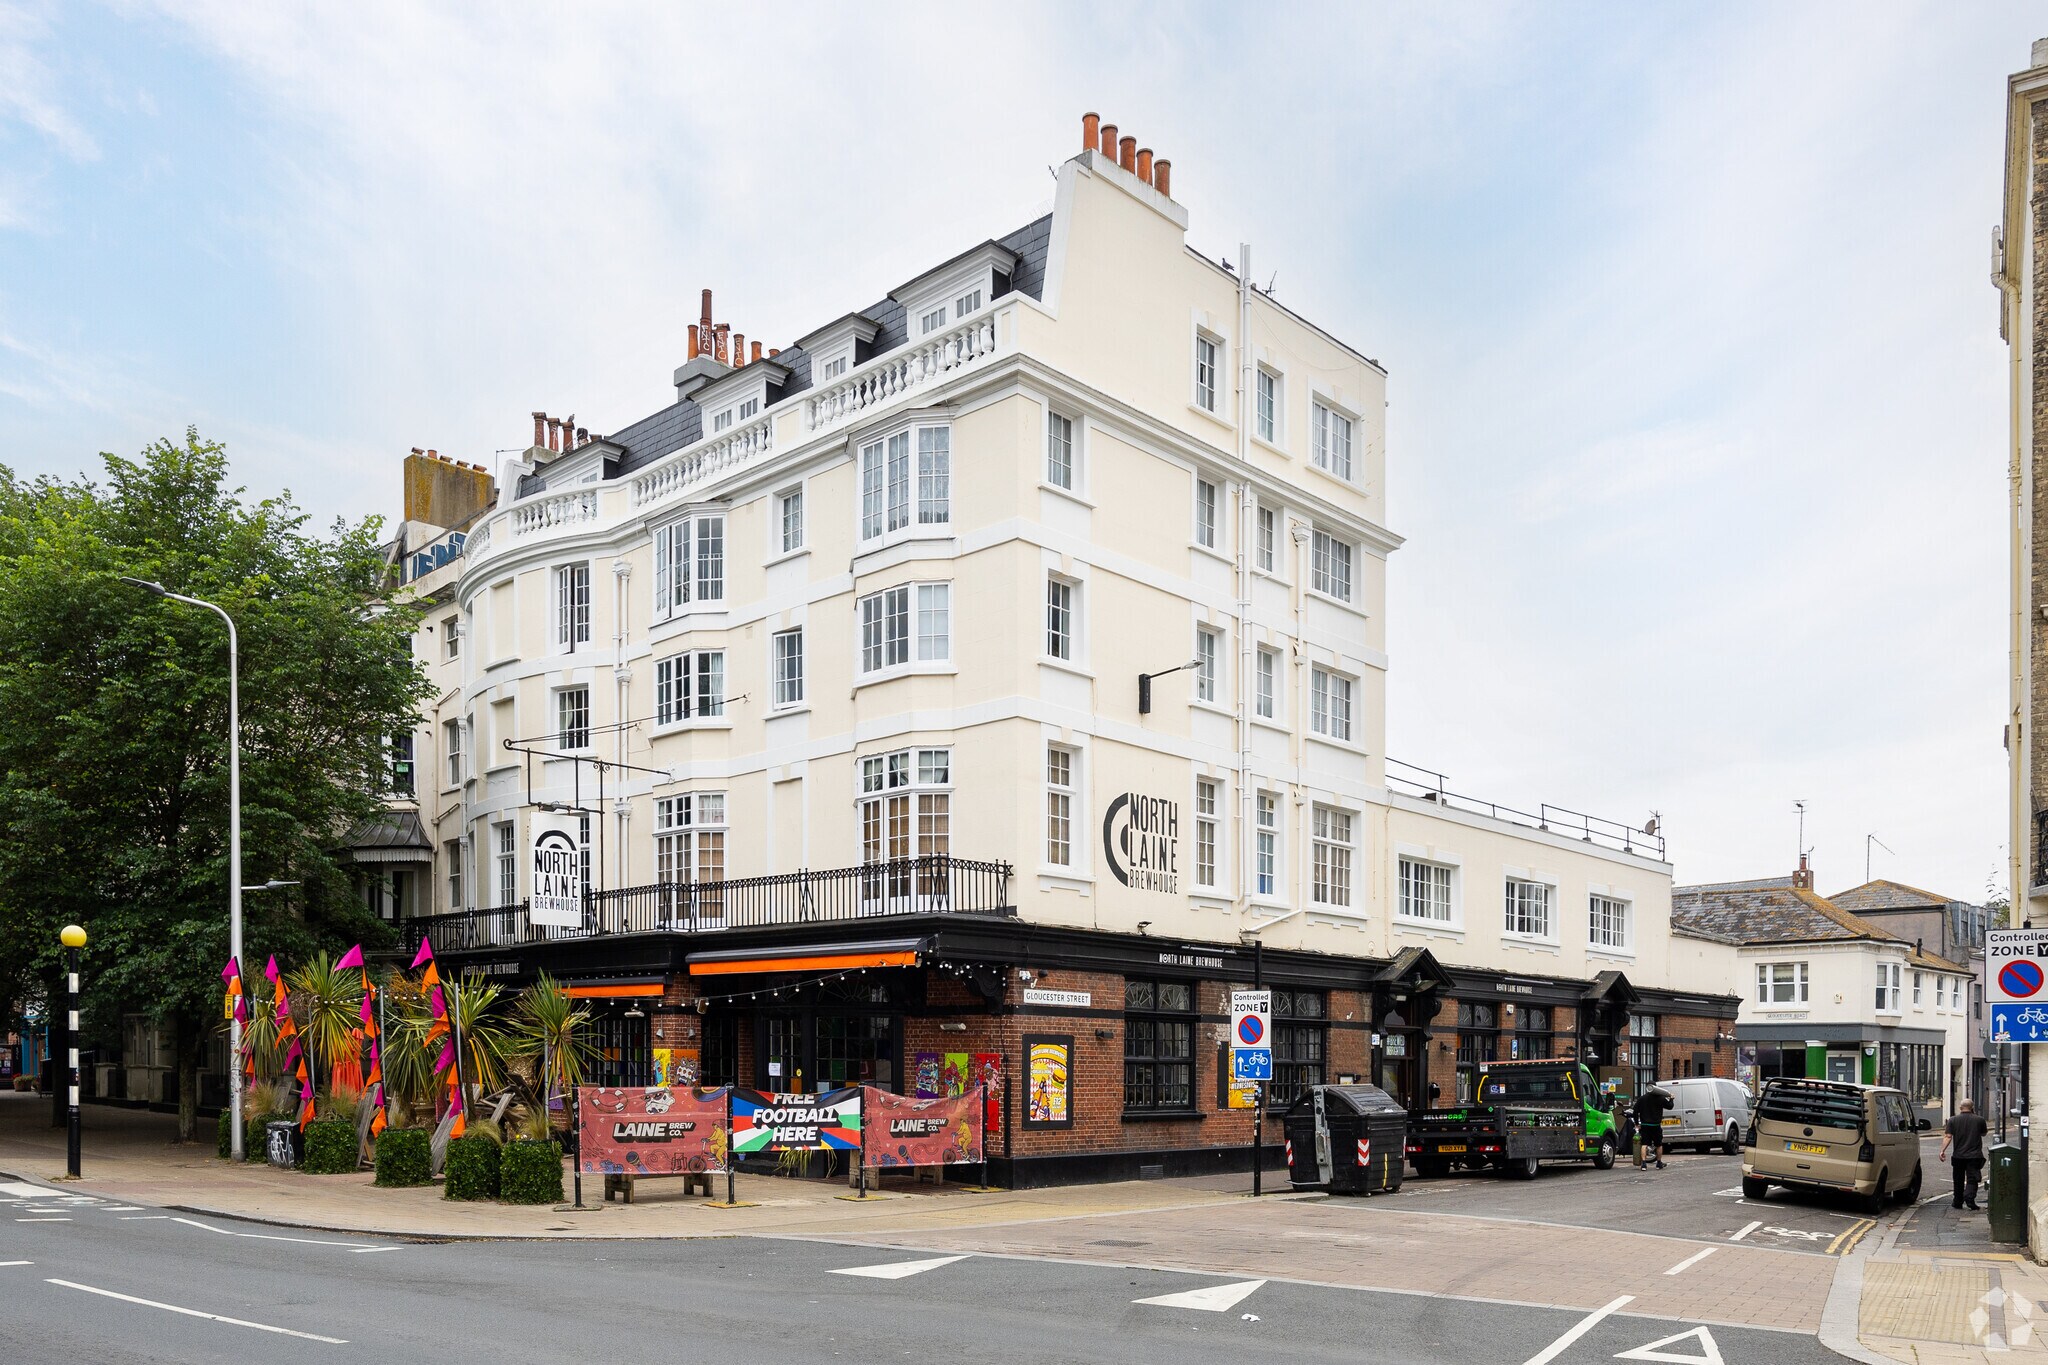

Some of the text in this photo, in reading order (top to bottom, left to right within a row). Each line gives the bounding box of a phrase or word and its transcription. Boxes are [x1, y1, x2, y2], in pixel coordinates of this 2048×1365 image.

[1130, 793, 1177, 838] NORTH
[1130, 832, 1178, 873] LAINE
[535, 849, 578, 876] NORTH
[535, 873, 578, 899] LAINE
[1130, 869, 1178, 894] BREWHOUSE
[535, 896, 578, 912] BREWHOUSE
[1991, 945, 2035, 957] ZONE
[1159, 953, 1223, 968] NORTH LAINE BREWHOUSE
[1026, 992, 1089, 1003] GLOUCESTER STREET
[1234, 993, 1269, 1001] Controlled
[1234, 1002, 1268, 1013] ZONE Y
[772, 1094, 815, 1105] FREE
[752, 1108, 838, 1124] FOOTBALL
[613, 1122, 694, 1137] LAINE BREW
[890, 1119, 926, 1133] LAINE
[771, 1126, 818, 1142] HERE
[1809, 1145, 1824, 1153] FTJ
